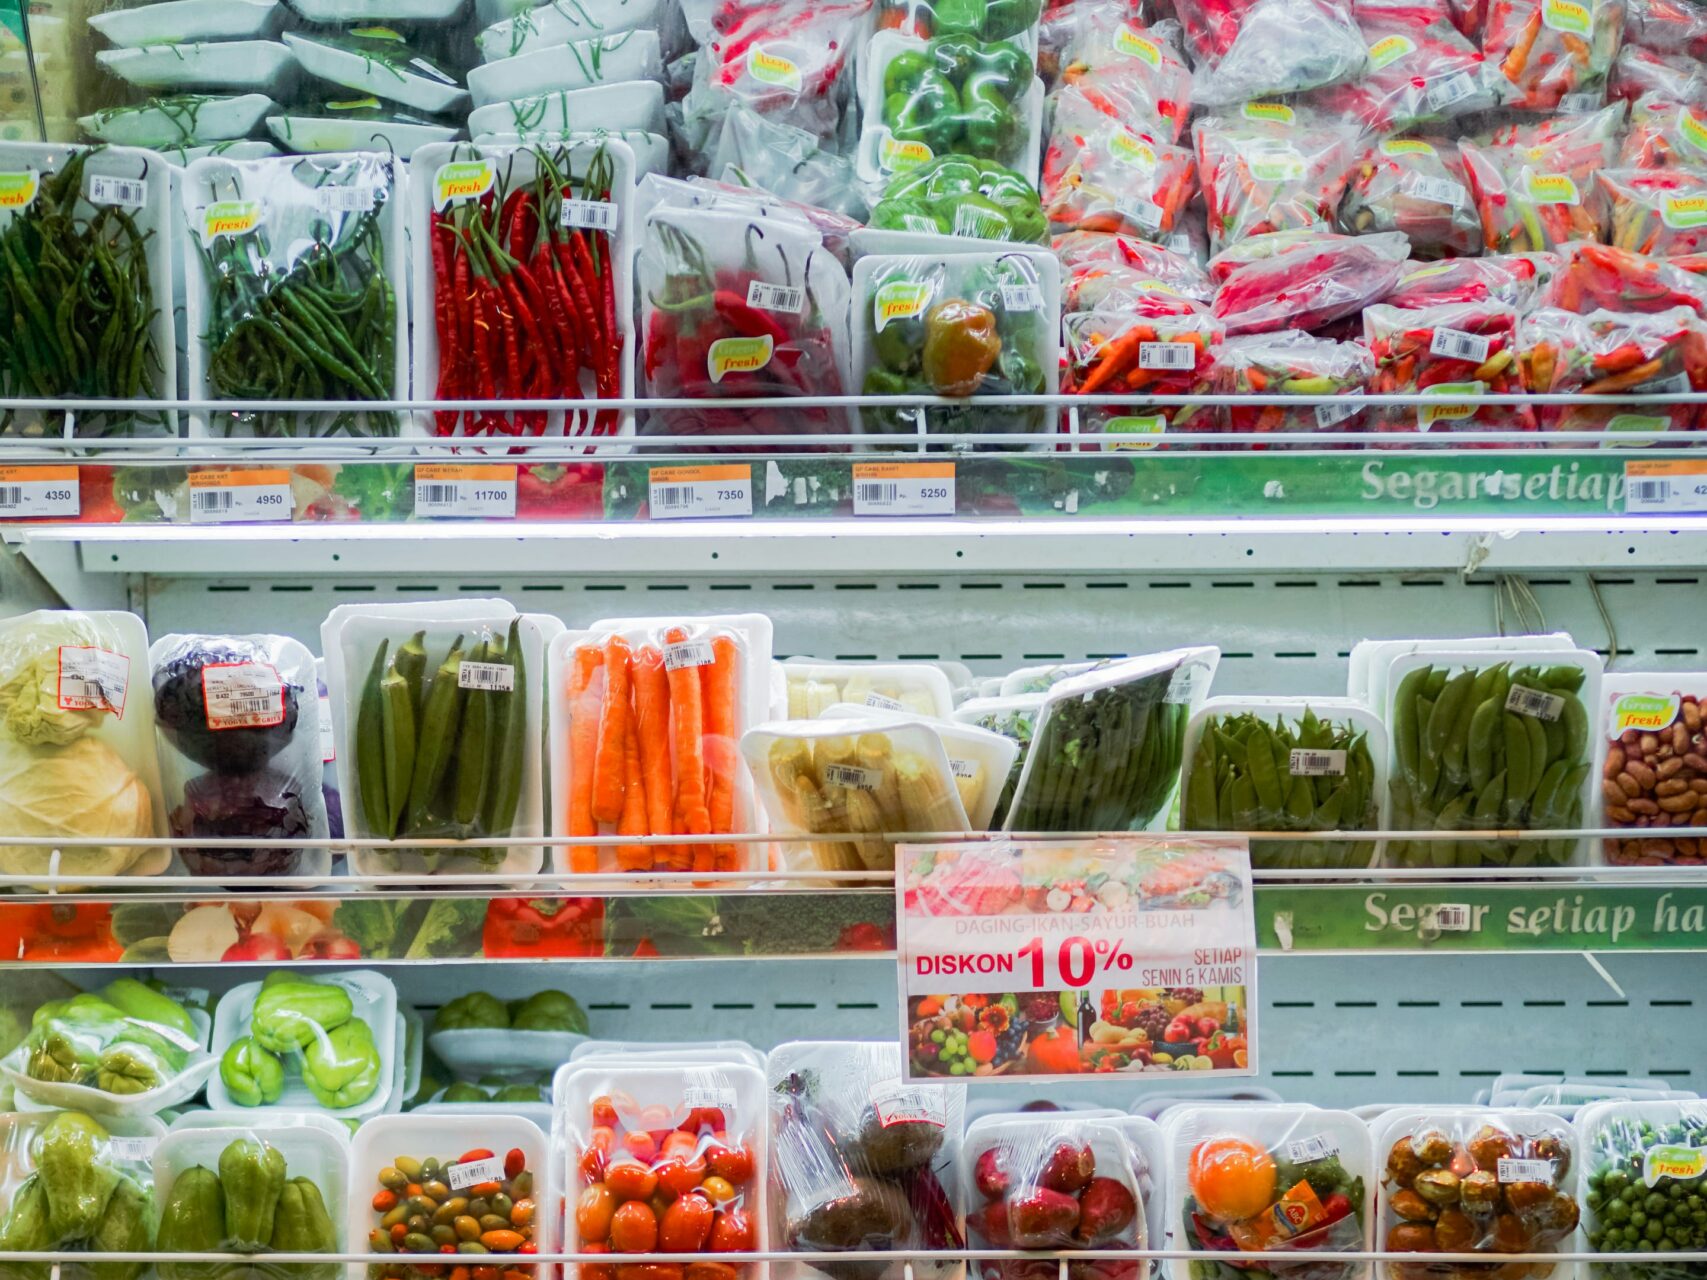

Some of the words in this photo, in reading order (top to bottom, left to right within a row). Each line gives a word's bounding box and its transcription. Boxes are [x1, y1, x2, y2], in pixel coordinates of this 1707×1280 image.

[447, 181, 481, 196] fresh
[724, 357, 759, 371] fresh
[1361, 460, 1487, 509] Segar
[1502, 461, 1625, 511] setiap
[45, 490, 71, 501] 4350
[256, 494, 283, 505] 4950
[474, 490, 508, 501] 11700
[717, 490, 744, 500] 7350
[920, 488, 947, 498] 5250
[1625, 714, 1662, 727] fresh
[955, 913, 1195, 935] DAGING-IKAN-SAYUR-BUAH
[1363, 892, 1490, 941] Segr
[1507, 895, 1636, 943] setiap
[916, 953, 1013, 976] DISKON
[1017, 935, 1133, 989] 10%
[1194, 947, 1242, 966] SETIAP
[1142, 968, 1181, 987] SENIN
[1185, 967, 1195, 985] &
[1198, 966, 1243, 986] KAMIS
